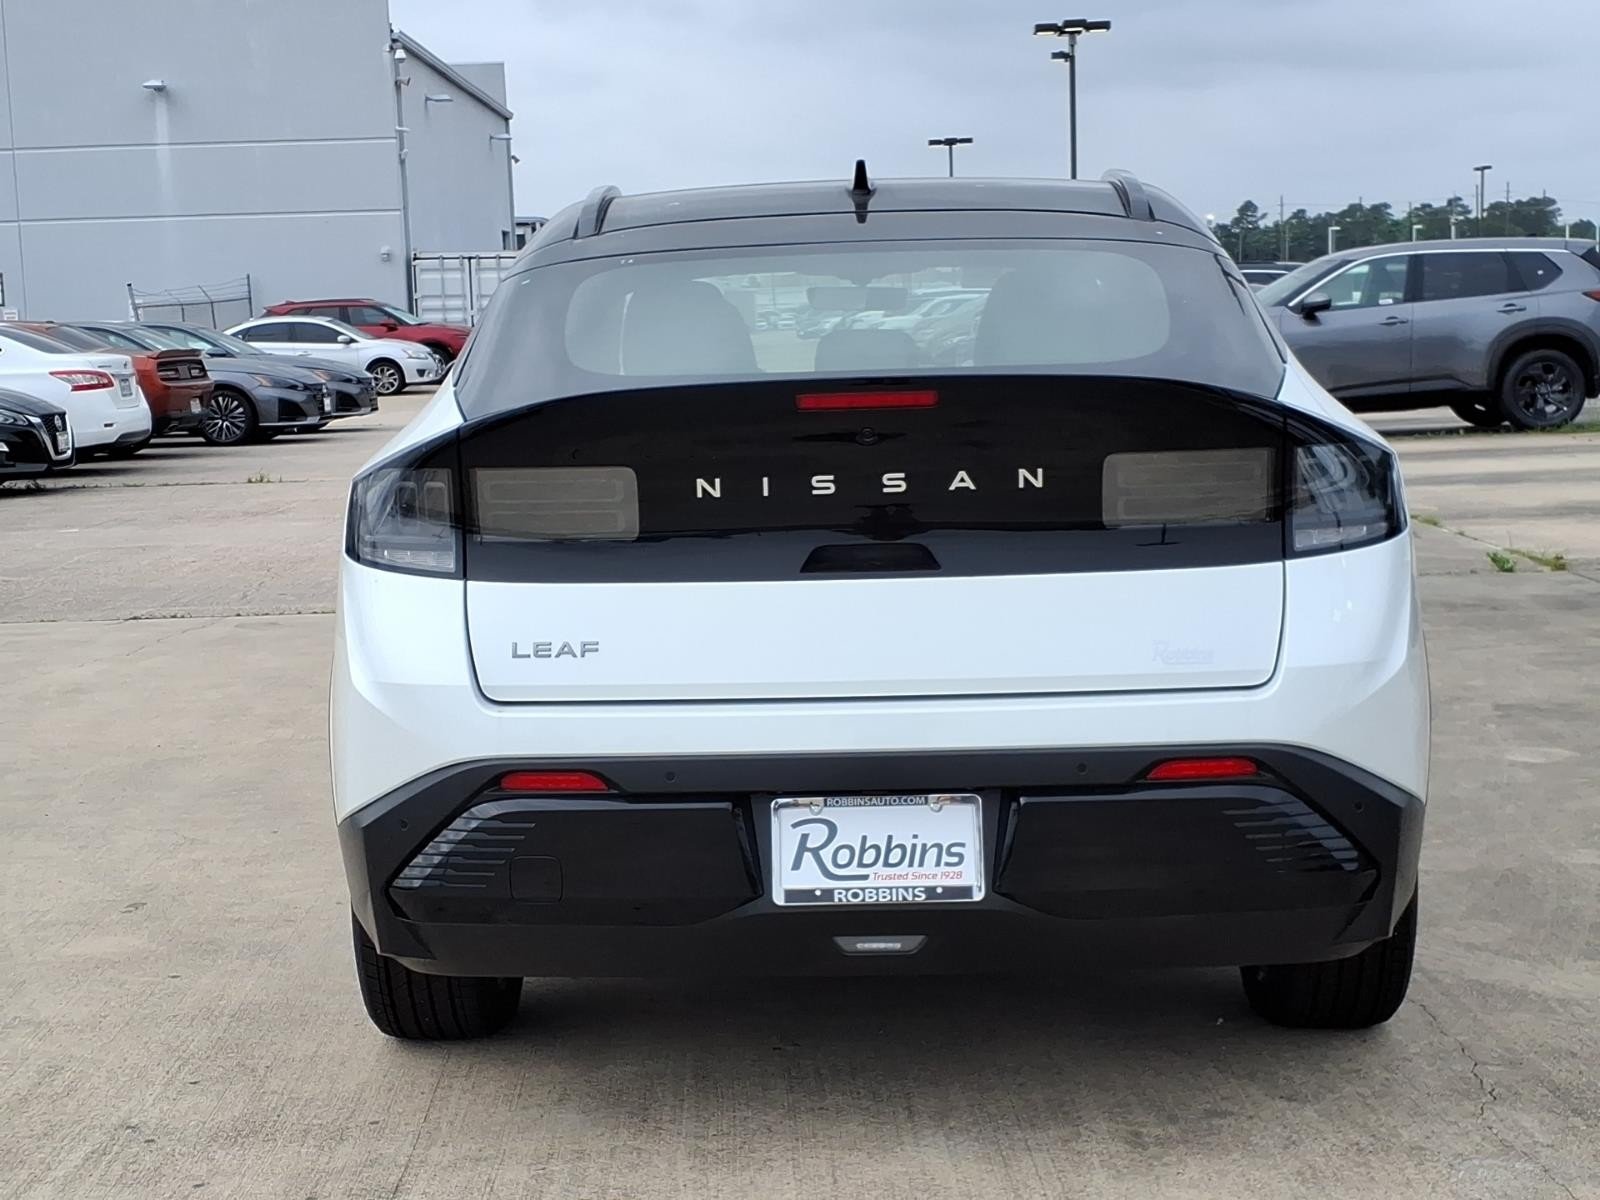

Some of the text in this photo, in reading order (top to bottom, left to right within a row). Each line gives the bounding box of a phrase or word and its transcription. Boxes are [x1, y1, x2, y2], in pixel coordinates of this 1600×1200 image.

[695, 467, 1044, 499] NISSAN
[511, 640, 599, 658] LEAF
[826, 795, 926, 807] ROBBINSAUTO.COM
[790, 817, 966, 881] Robbins
[873, 870, 963, 881] Trusted Since 1928
[834, 886, 926, 902] ROBBINS
